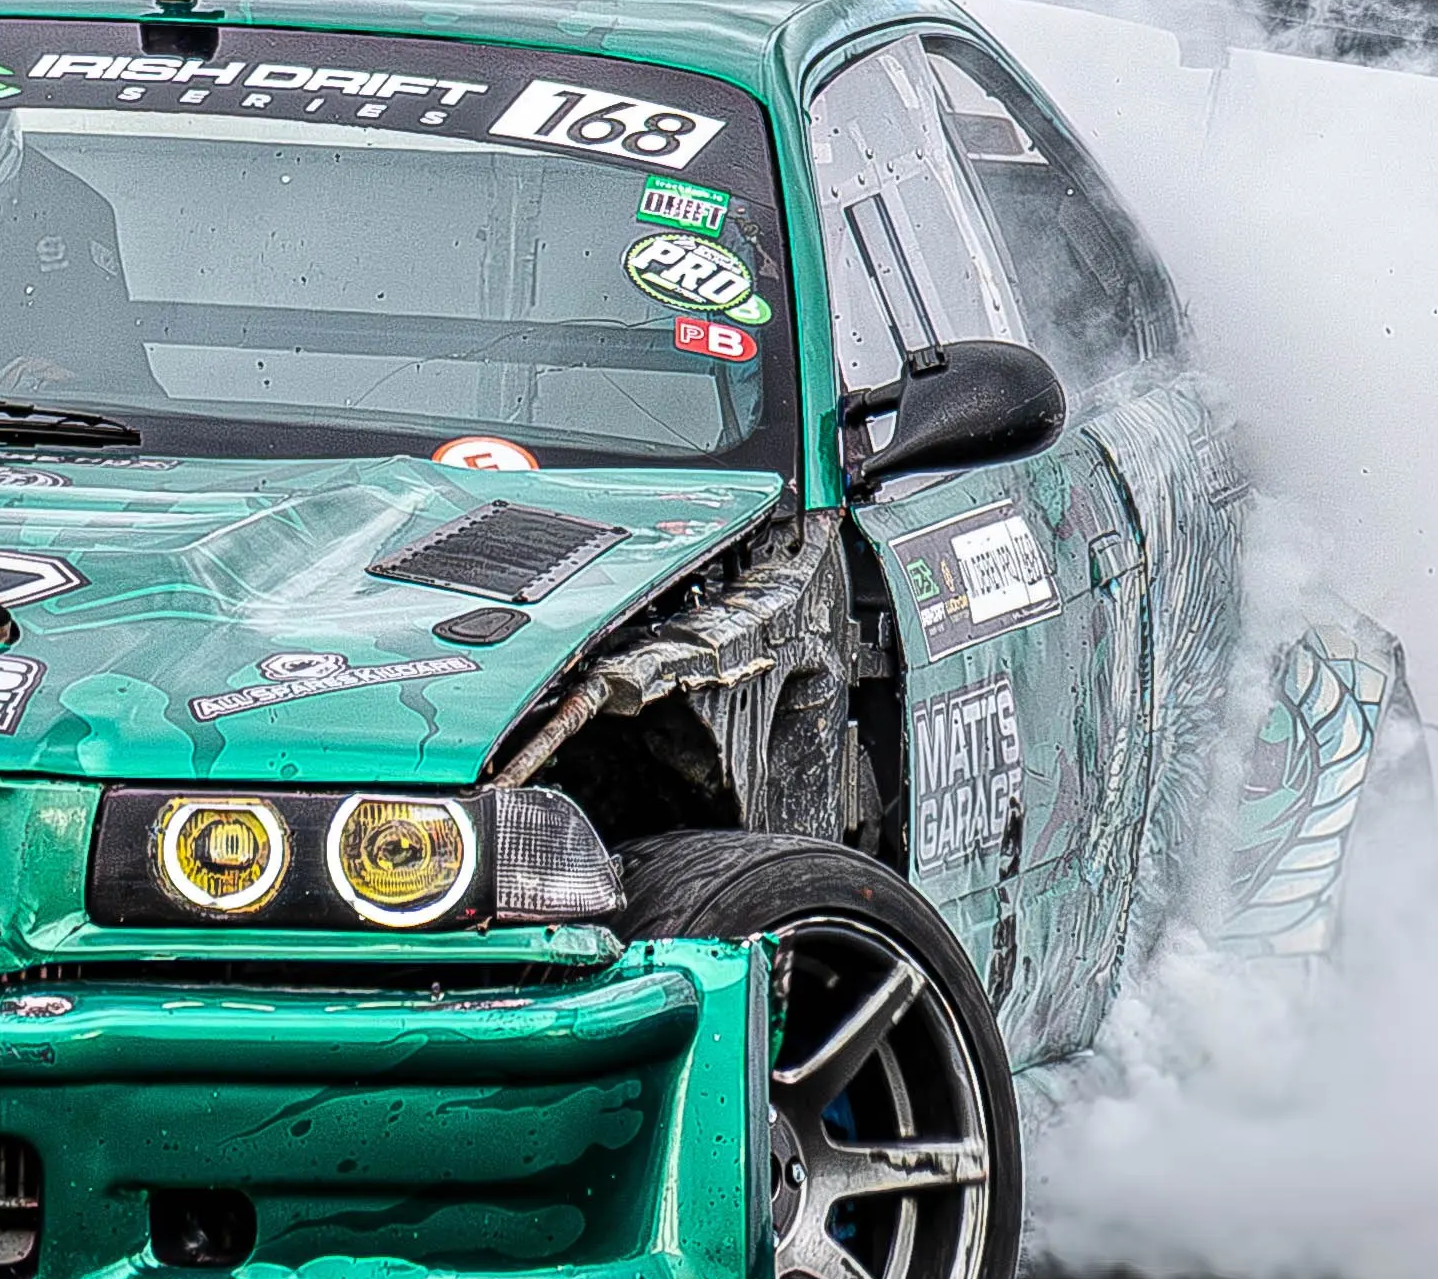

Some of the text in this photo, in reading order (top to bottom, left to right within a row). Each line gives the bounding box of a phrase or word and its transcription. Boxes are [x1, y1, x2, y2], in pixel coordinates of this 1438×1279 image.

[28, 53, 489, 106] IRISH DRIFT
[117, 86, 449, 126] SERIES
[534, 90, 697, 157] 168
[629, 238, 751, 304] PRO
[916, 689, 1020, 796] MATTS
